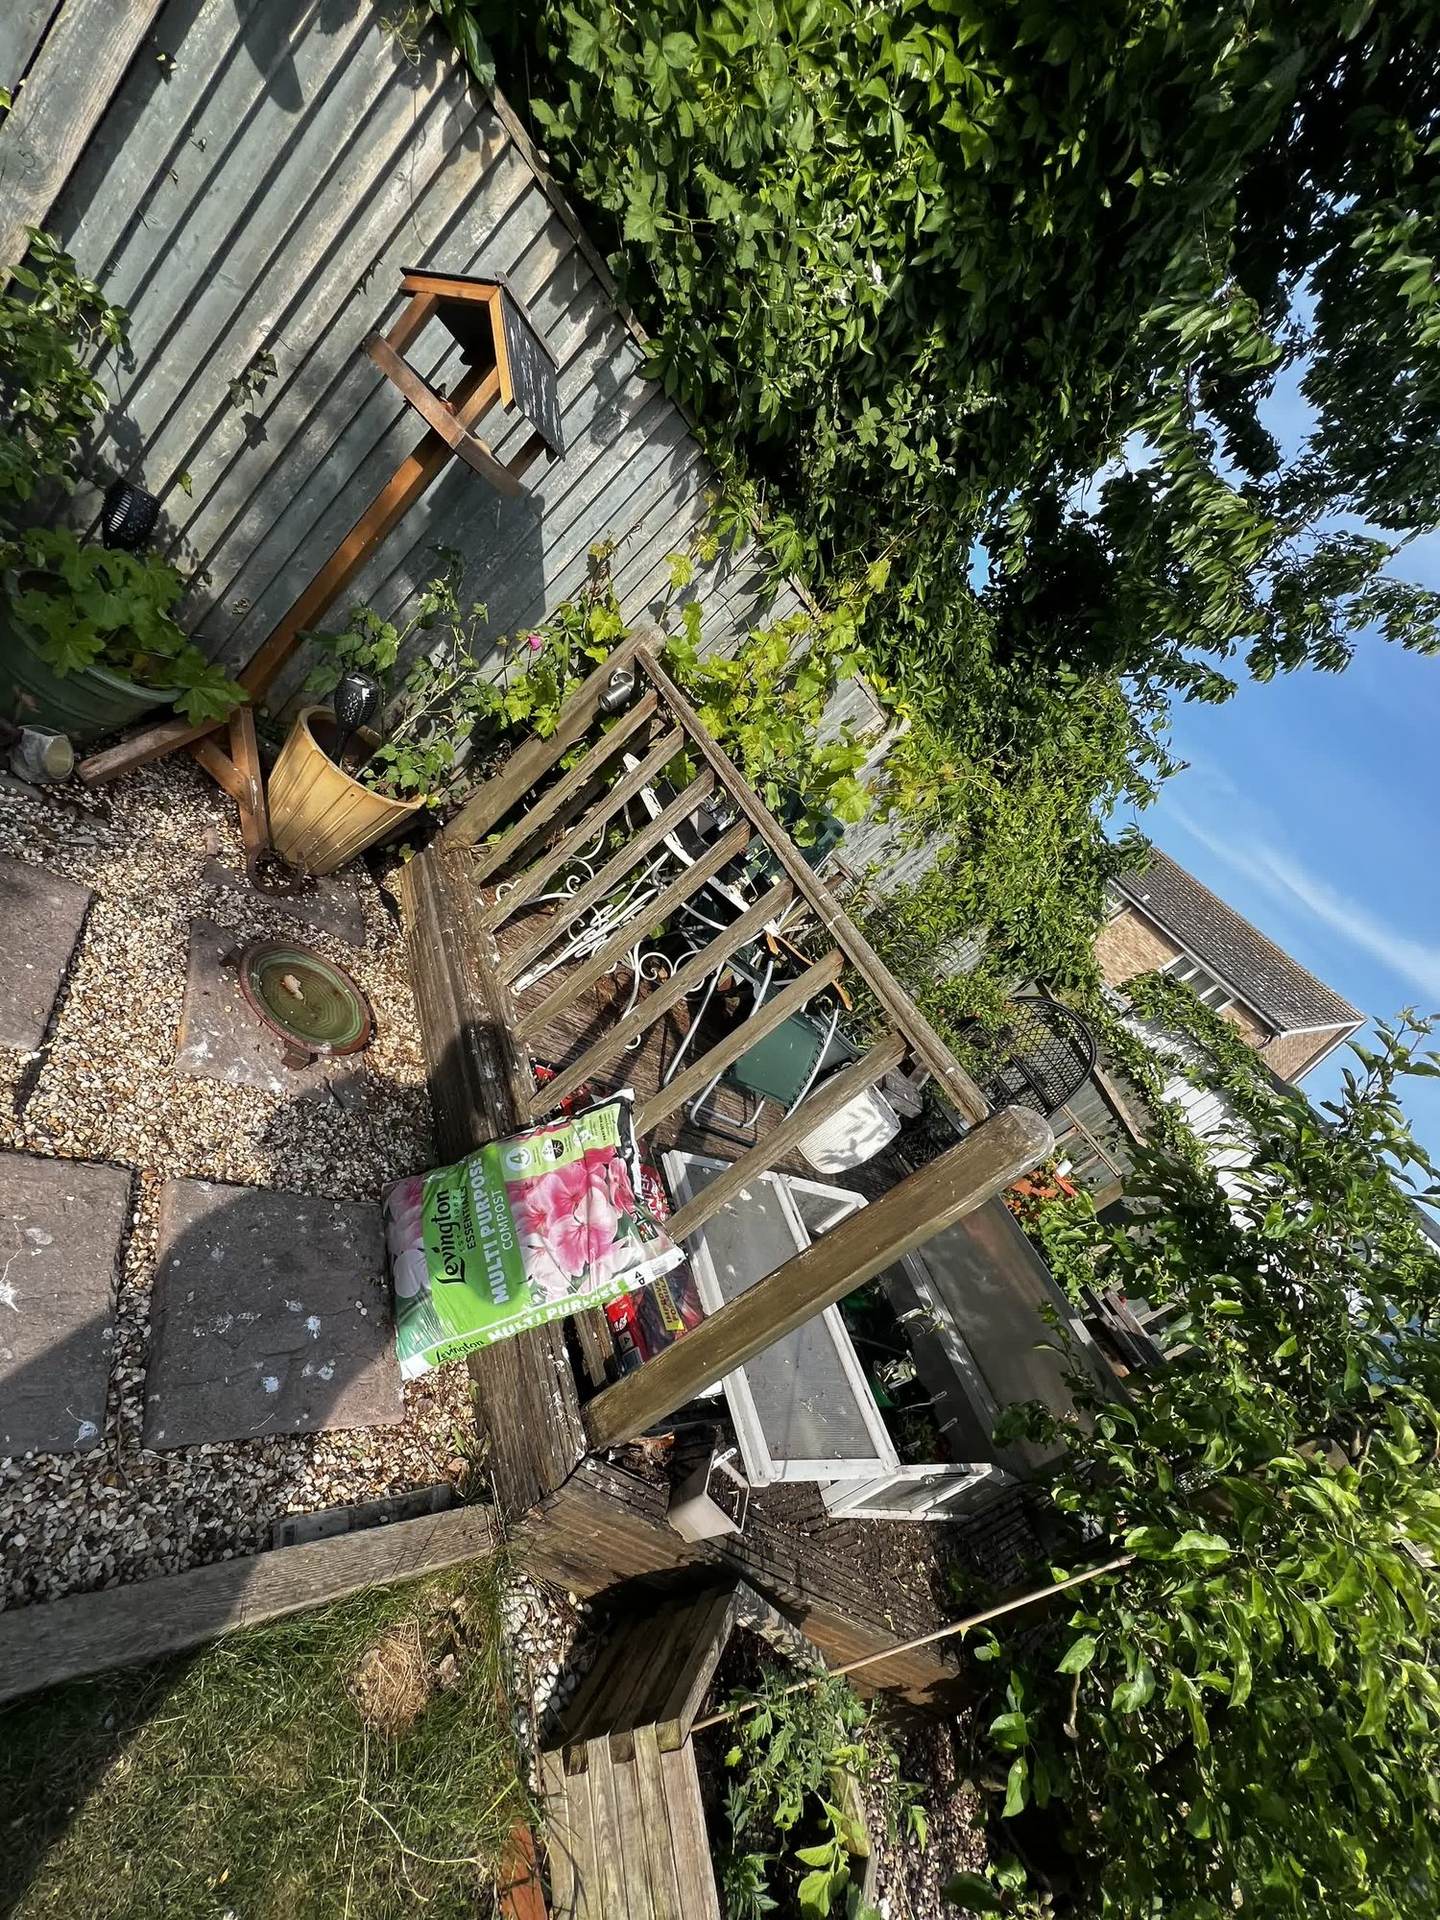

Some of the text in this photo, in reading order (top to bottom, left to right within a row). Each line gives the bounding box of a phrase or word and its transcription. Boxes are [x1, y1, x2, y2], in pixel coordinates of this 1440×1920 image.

[431, 1189, 467, 1284] Levington
[459, 1186, 477, 1250] ESSENTIALS
[469, 1157, 510, 1305] MULTI PURPOSE
[492, 1190, 513, 1251] COMPOST
[436, 1339, 484, 1362] Levington
[487, 1313, 542, 1342] MULTI
